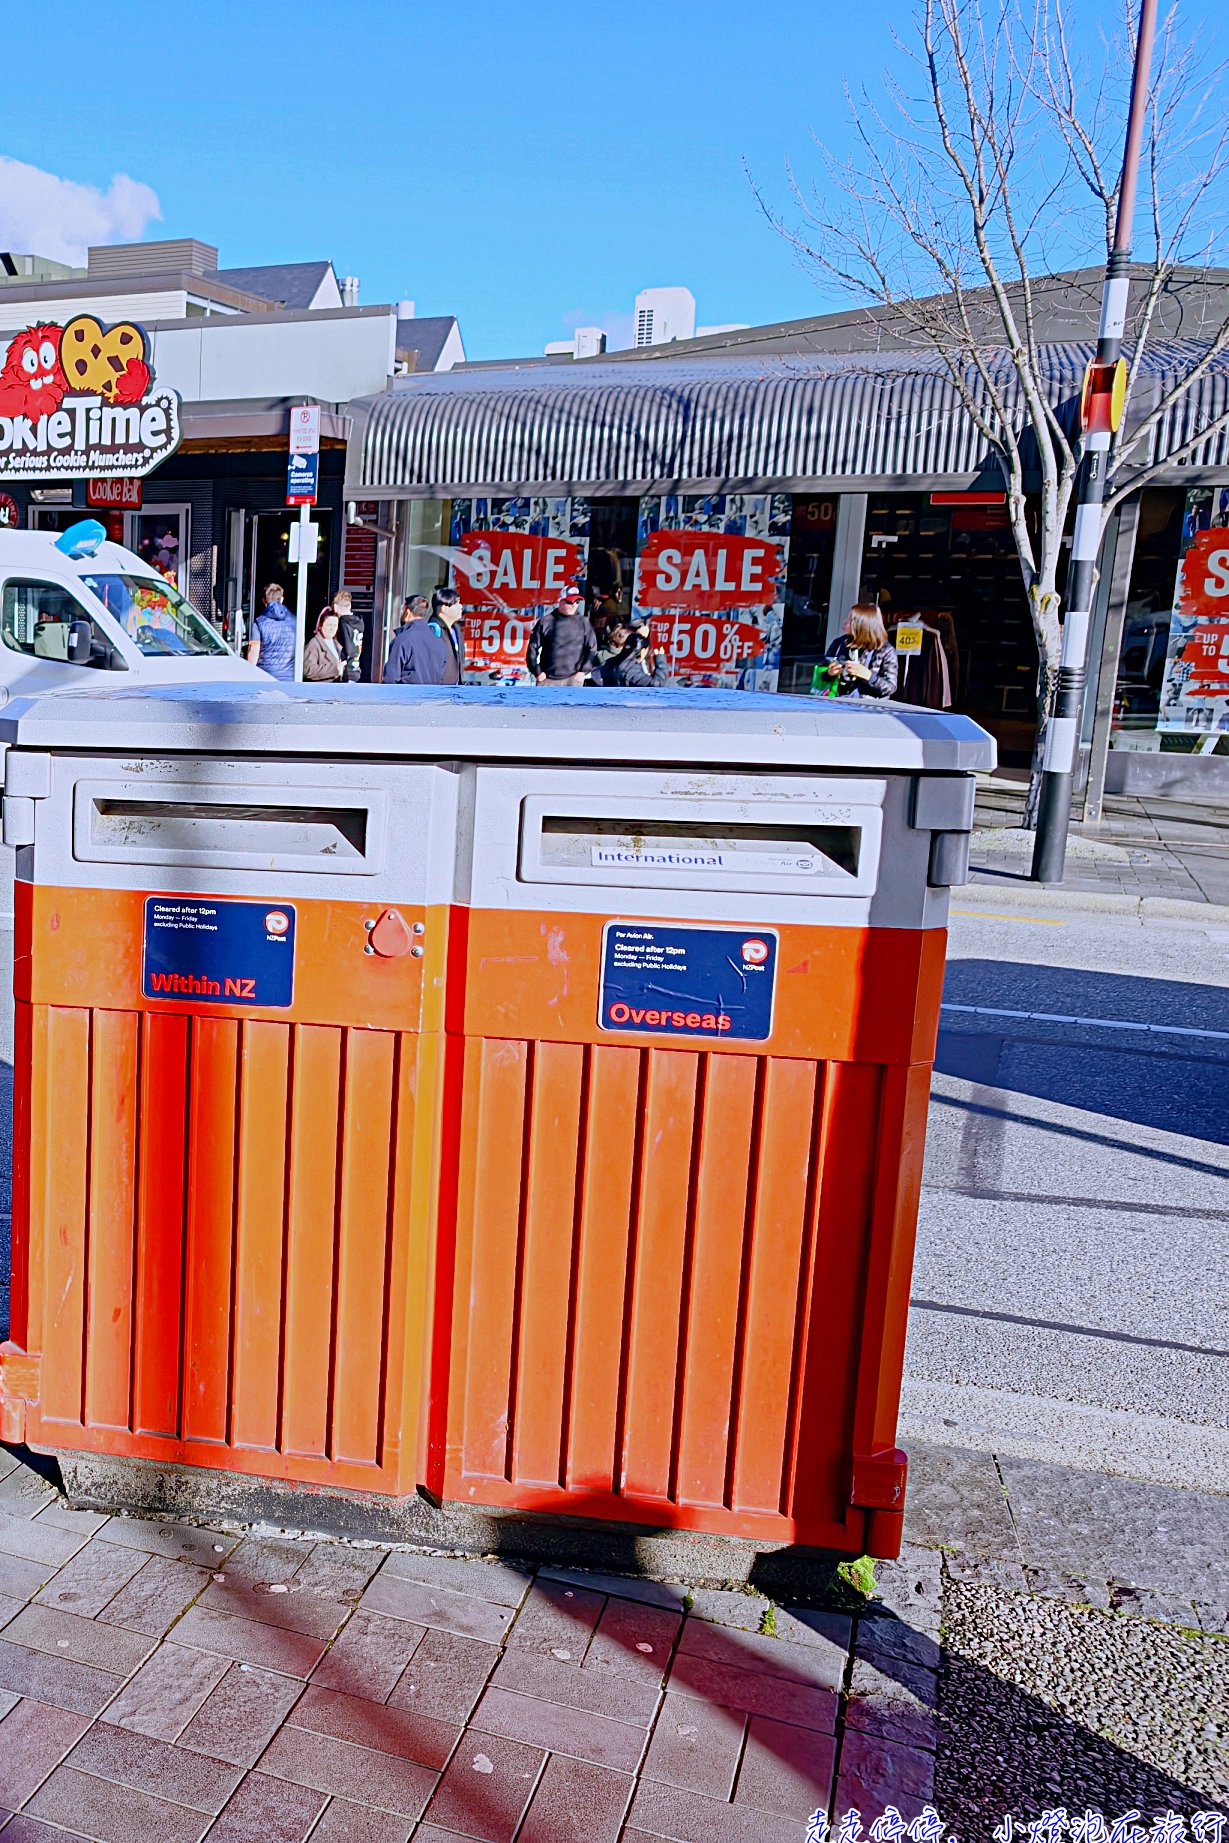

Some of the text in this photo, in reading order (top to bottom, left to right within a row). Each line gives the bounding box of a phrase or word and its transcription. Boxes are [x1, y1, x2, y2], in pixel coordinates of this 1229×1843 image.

[8, 453, 48, 468] Serious
[49, 452, 86, 468] Cookie
[470, 548, 566, 590] SALE
[656, 548, 766, 591] SALE
[470, 619, 482, 629] UP
[657, 623, 669, 632] UP
[470, 629, 481, 638] TO
[657, 632, 668, 642] TO
[1202, 634, 1218, 645] UP
[720, 641, 753, 659] OFF
[1202, 645, 1216, 656] TO
[597, 851, 724, 866] International
[154, 905, 217, 916] Cleared after 12pm
[195, 923, 218, 931] Holidays
[614, 943, 686, 956] Cleared after 12pm
[614, 952, 638, 961] Monday
[645, 954, 665, 963] Friday
[613, 961, 642, 969] excluding
[661, 963, 687, 971] Holidays
[150, 972, 256, 998] Within NZ
[608, 1002, 732, 1032] Overseas
